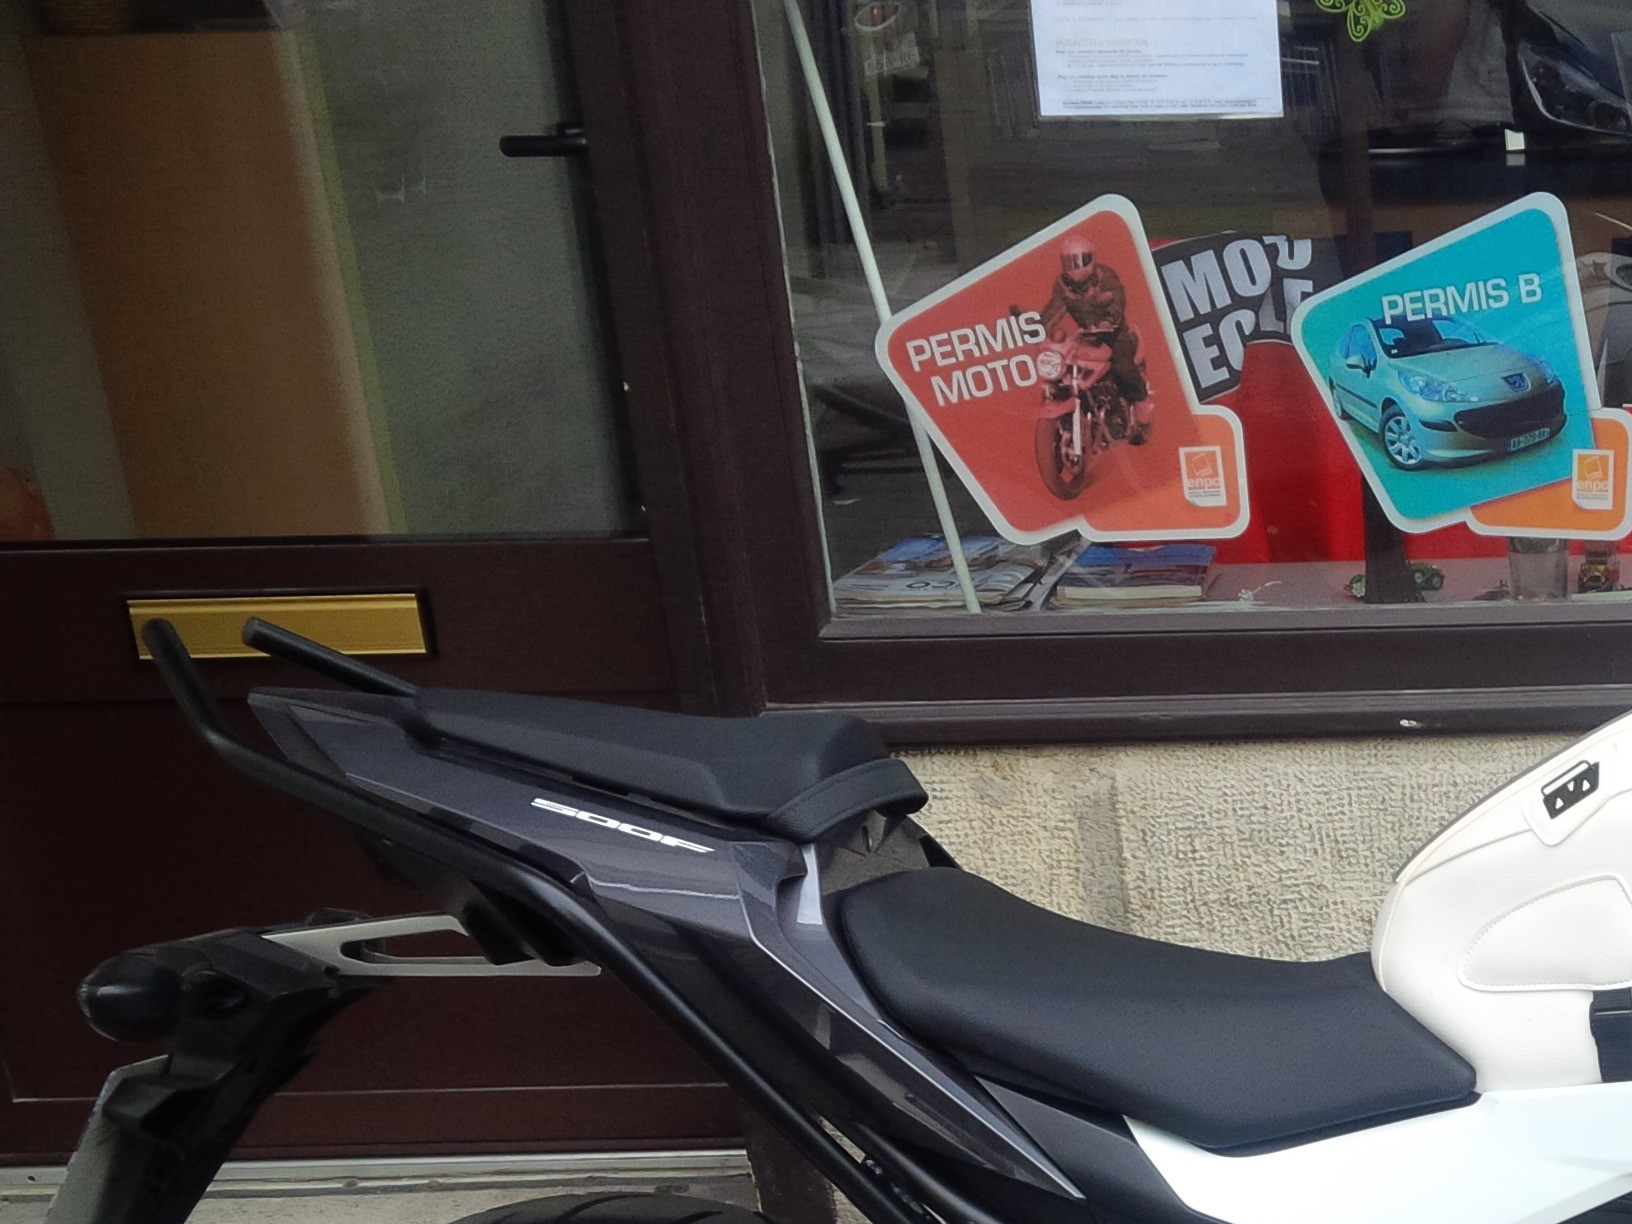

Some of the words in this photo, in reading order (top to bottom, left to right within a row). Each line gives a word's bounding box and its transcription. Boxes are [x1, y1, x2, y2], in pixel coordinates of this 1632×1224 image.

[1381, 277, 1509, 325] PERMIS
[1518, 273, 1543, 303] B
[906, 311, 1046, 372] PERMIS
[930, 354, 1039, 406] MOTO
